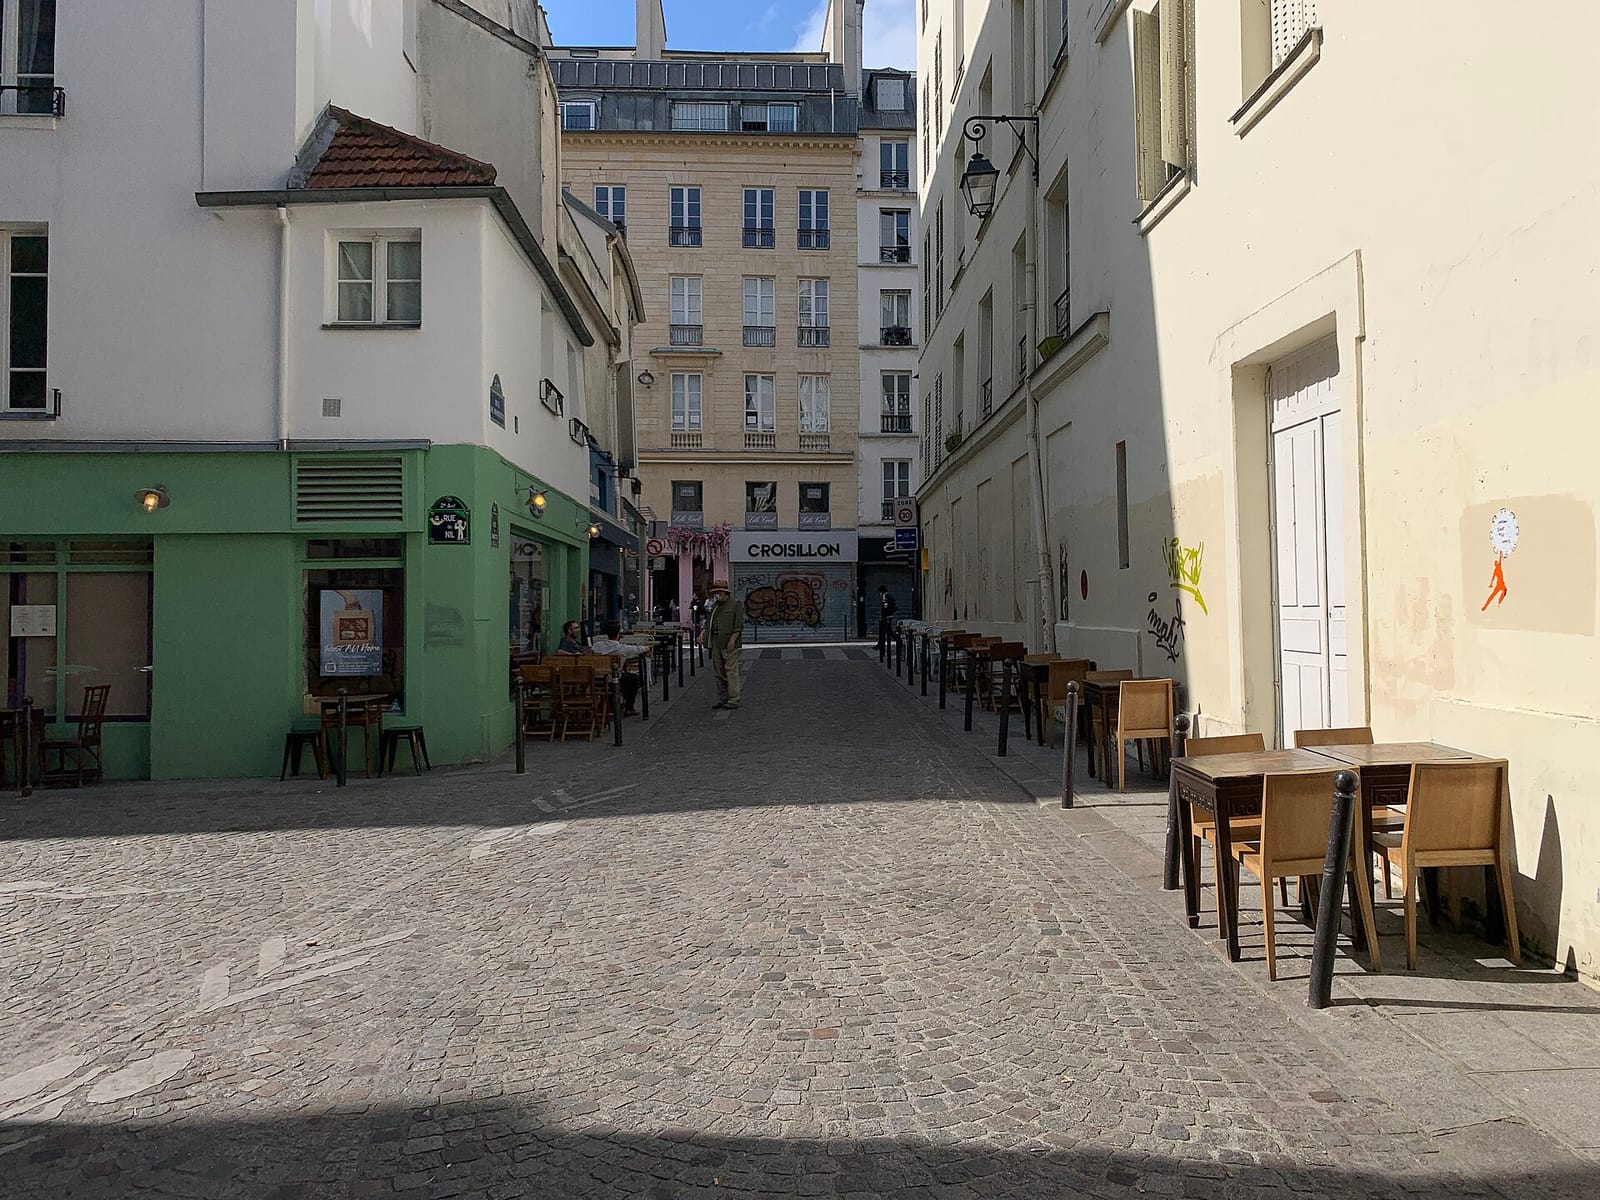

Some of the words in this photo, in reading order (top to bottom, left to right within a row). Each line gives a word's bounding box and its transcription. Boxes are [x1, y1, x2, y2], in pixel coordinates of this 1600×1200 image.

[443, 514, 457, 522] RUE
[901, 511, 910, 519] 30
[444, 530, 456, 539] NIL
[747, 542, 841, 557] CROISILLON
